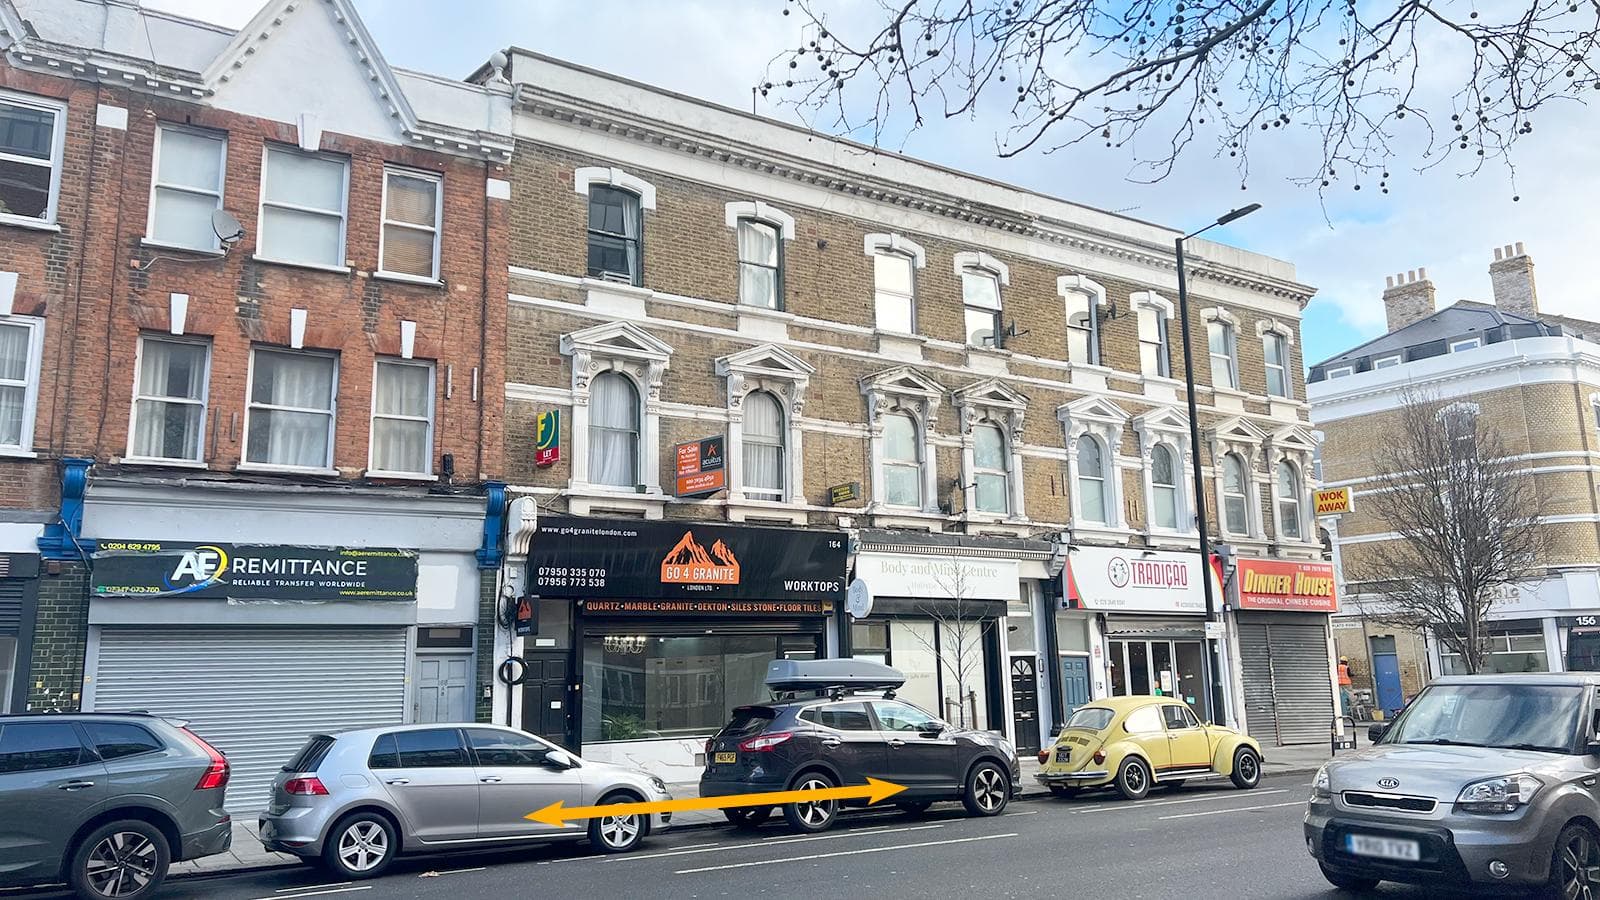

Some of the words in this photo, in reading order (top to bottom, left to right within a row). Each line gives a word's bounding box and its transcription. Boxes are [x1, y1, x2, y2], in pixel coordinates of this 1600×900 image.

[543, 449, 552, 458] LET
[702, 455, 721, 466] acuitus
[1318, 491, 1343, 501] WOK
[1318, 501, 1346, 512] AWAY
[541, 526, 637, 537] www.go4granitelondon.com
[171, 551, 218, 581] AE
[232, 557, 368, 576] REMITTANCE
[881, 560, 907, 577] Body
[911, 563, 932, 575] and
[538, 567, 568, 576] 07950
[569, 568, 587, 577] 335
[589, 569, 606, 577] 070
[666, 566, 680, 579] GO
[683, 567, 690, 579] 4
[693, 567, 735, 580] GRANITE
[232, 579, 271, 587] RELIABLE
[275, 580, 315, 588] TRANSFER
[537, 577, 567, 586] 07956
[570, 578, 587, 587] 773
[588, 579, 606, 587] 538
[784, 580, 840, 592] WORKTOPS
[1243, 569, 1292, 594] DINNER
[1293, 571, 1333, 596] HOUSE
[1257, 597, 1285, 605] ORIGINAL
[586, 602, 621, 611] QUARTZ
[624, 602, 658, 611] MARBLE
[660, 602, 695, 611] GRANITE
[697, 603, 727, 611] DEKTON
[731, 603, 752, 611] SILES
[753, 603, 777, 612] STONE
[779, 603, 802, 612] FLOOR
[1576, 616, 1596, 626] 156
[1380, 779, 1397, 787] KIA
